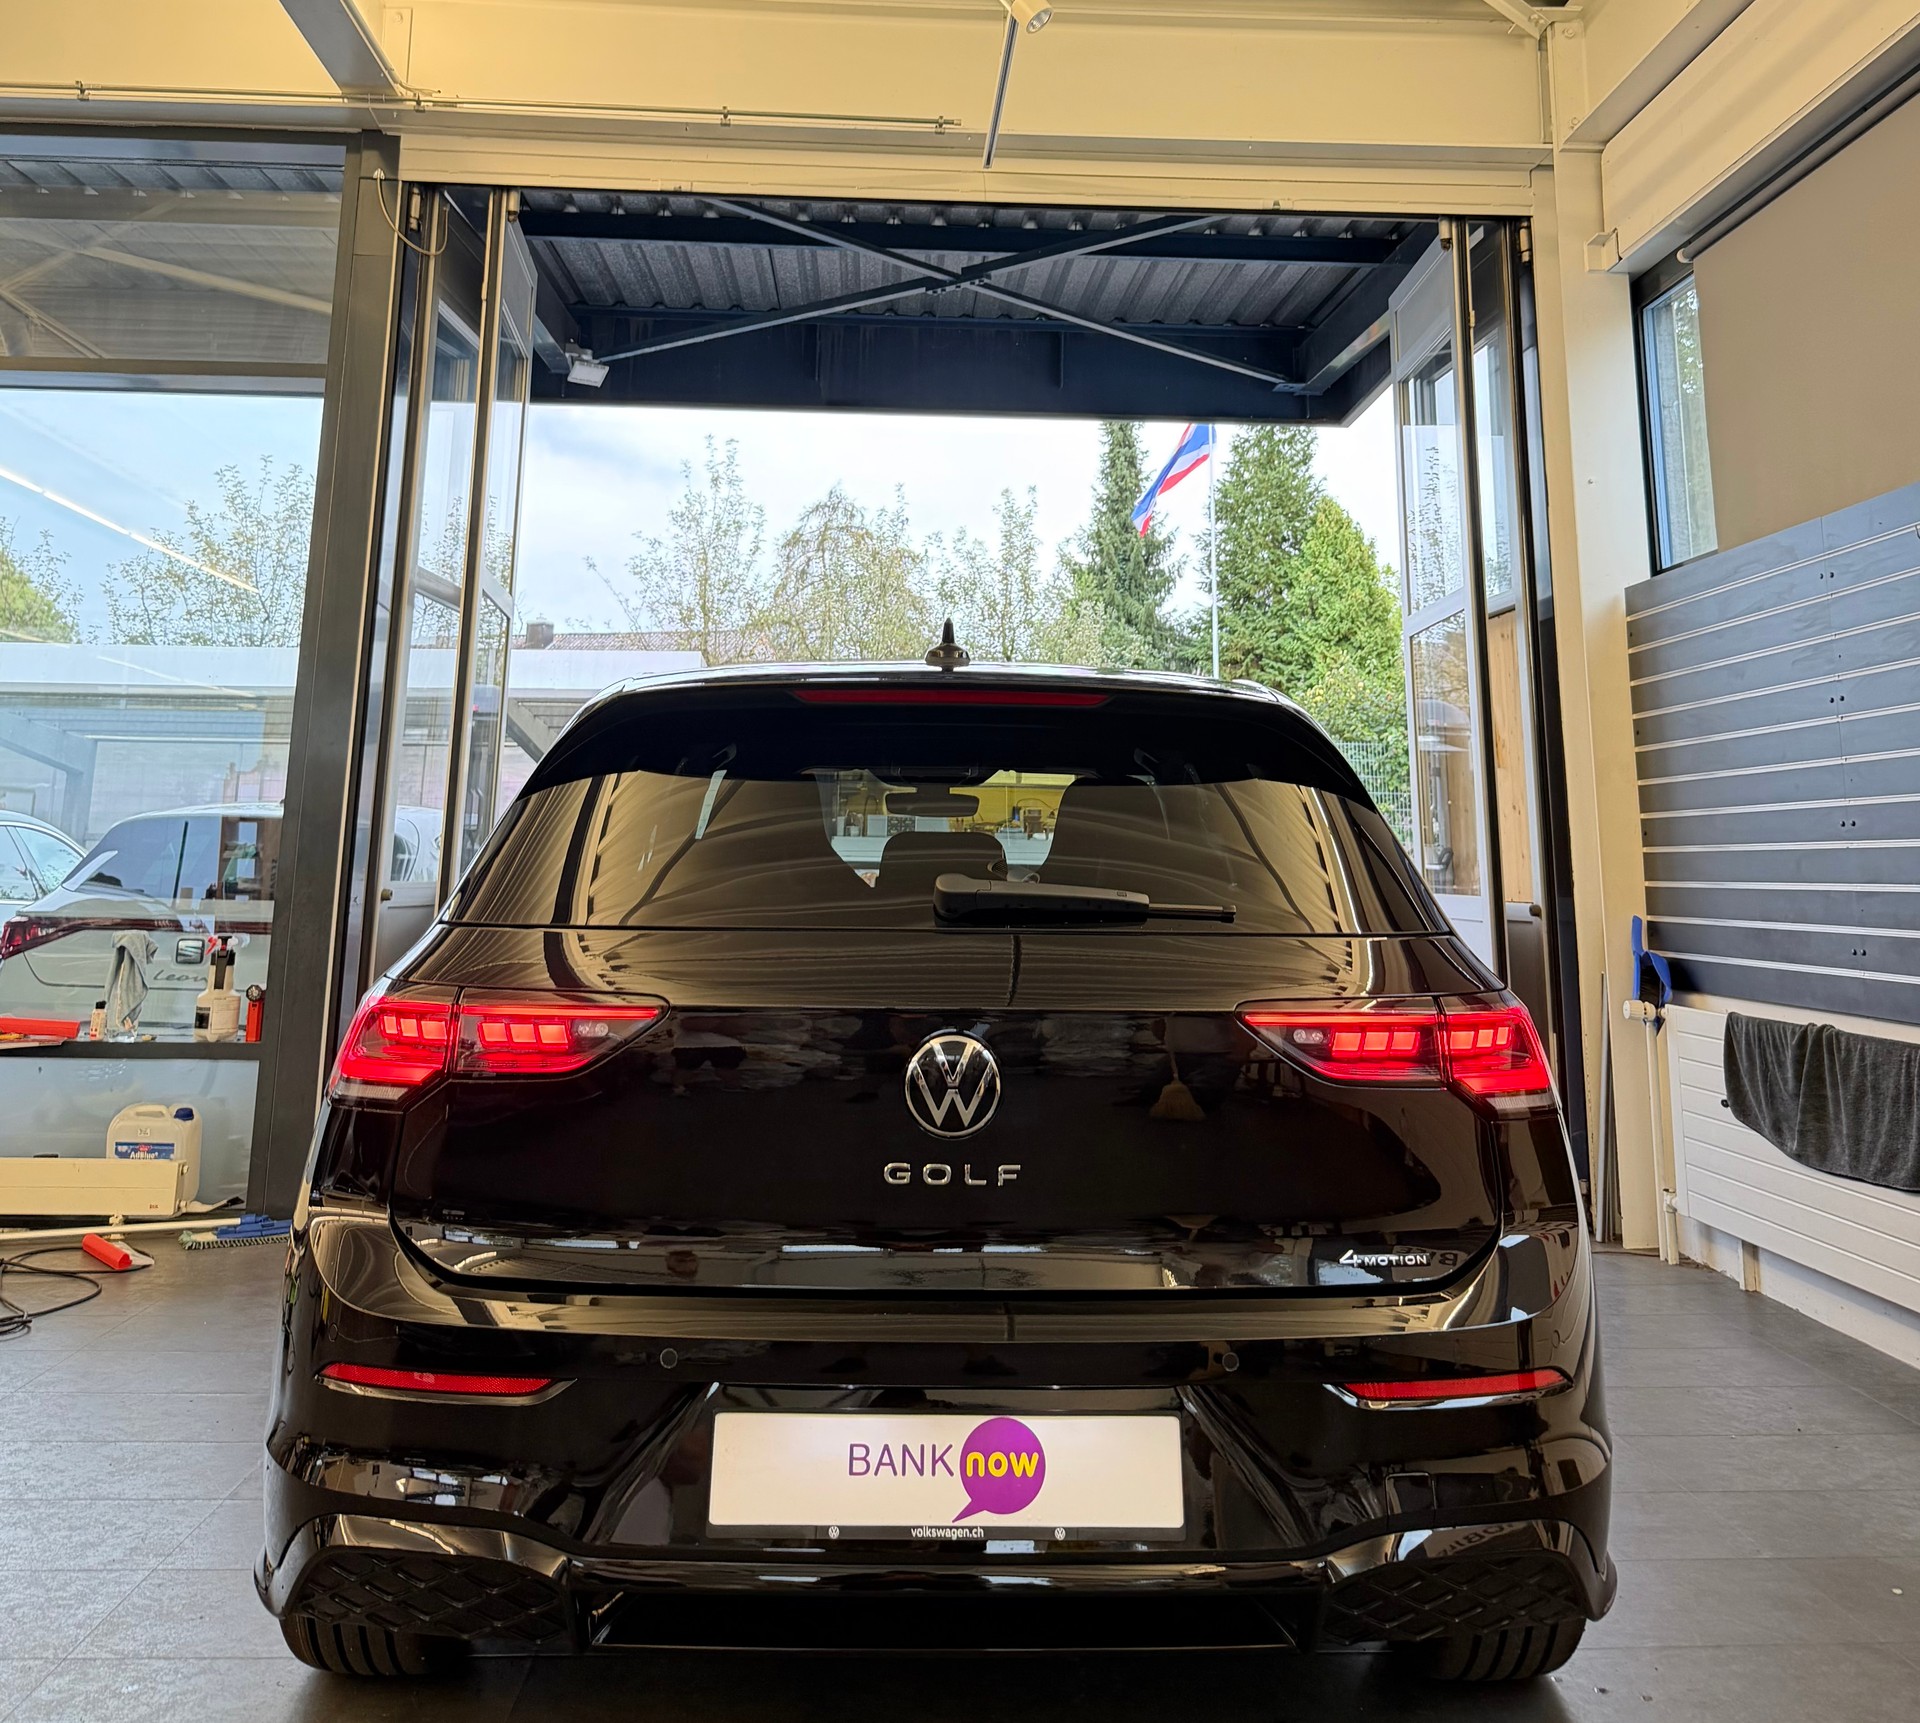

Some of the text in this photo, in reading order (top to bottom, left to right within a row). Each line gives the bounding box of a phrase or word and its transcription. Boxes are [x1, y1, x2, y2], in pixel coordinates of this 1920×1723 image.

[153, 969, 208, 984] Leon
[883, 1162, 1021, 1187] GOLF
[1338, 1249, 1428, 1267] 4MOTION
[848, 1443, 1039, 1478] BANK now
[910, 1526, 985, 1541] volkswagen.ch
